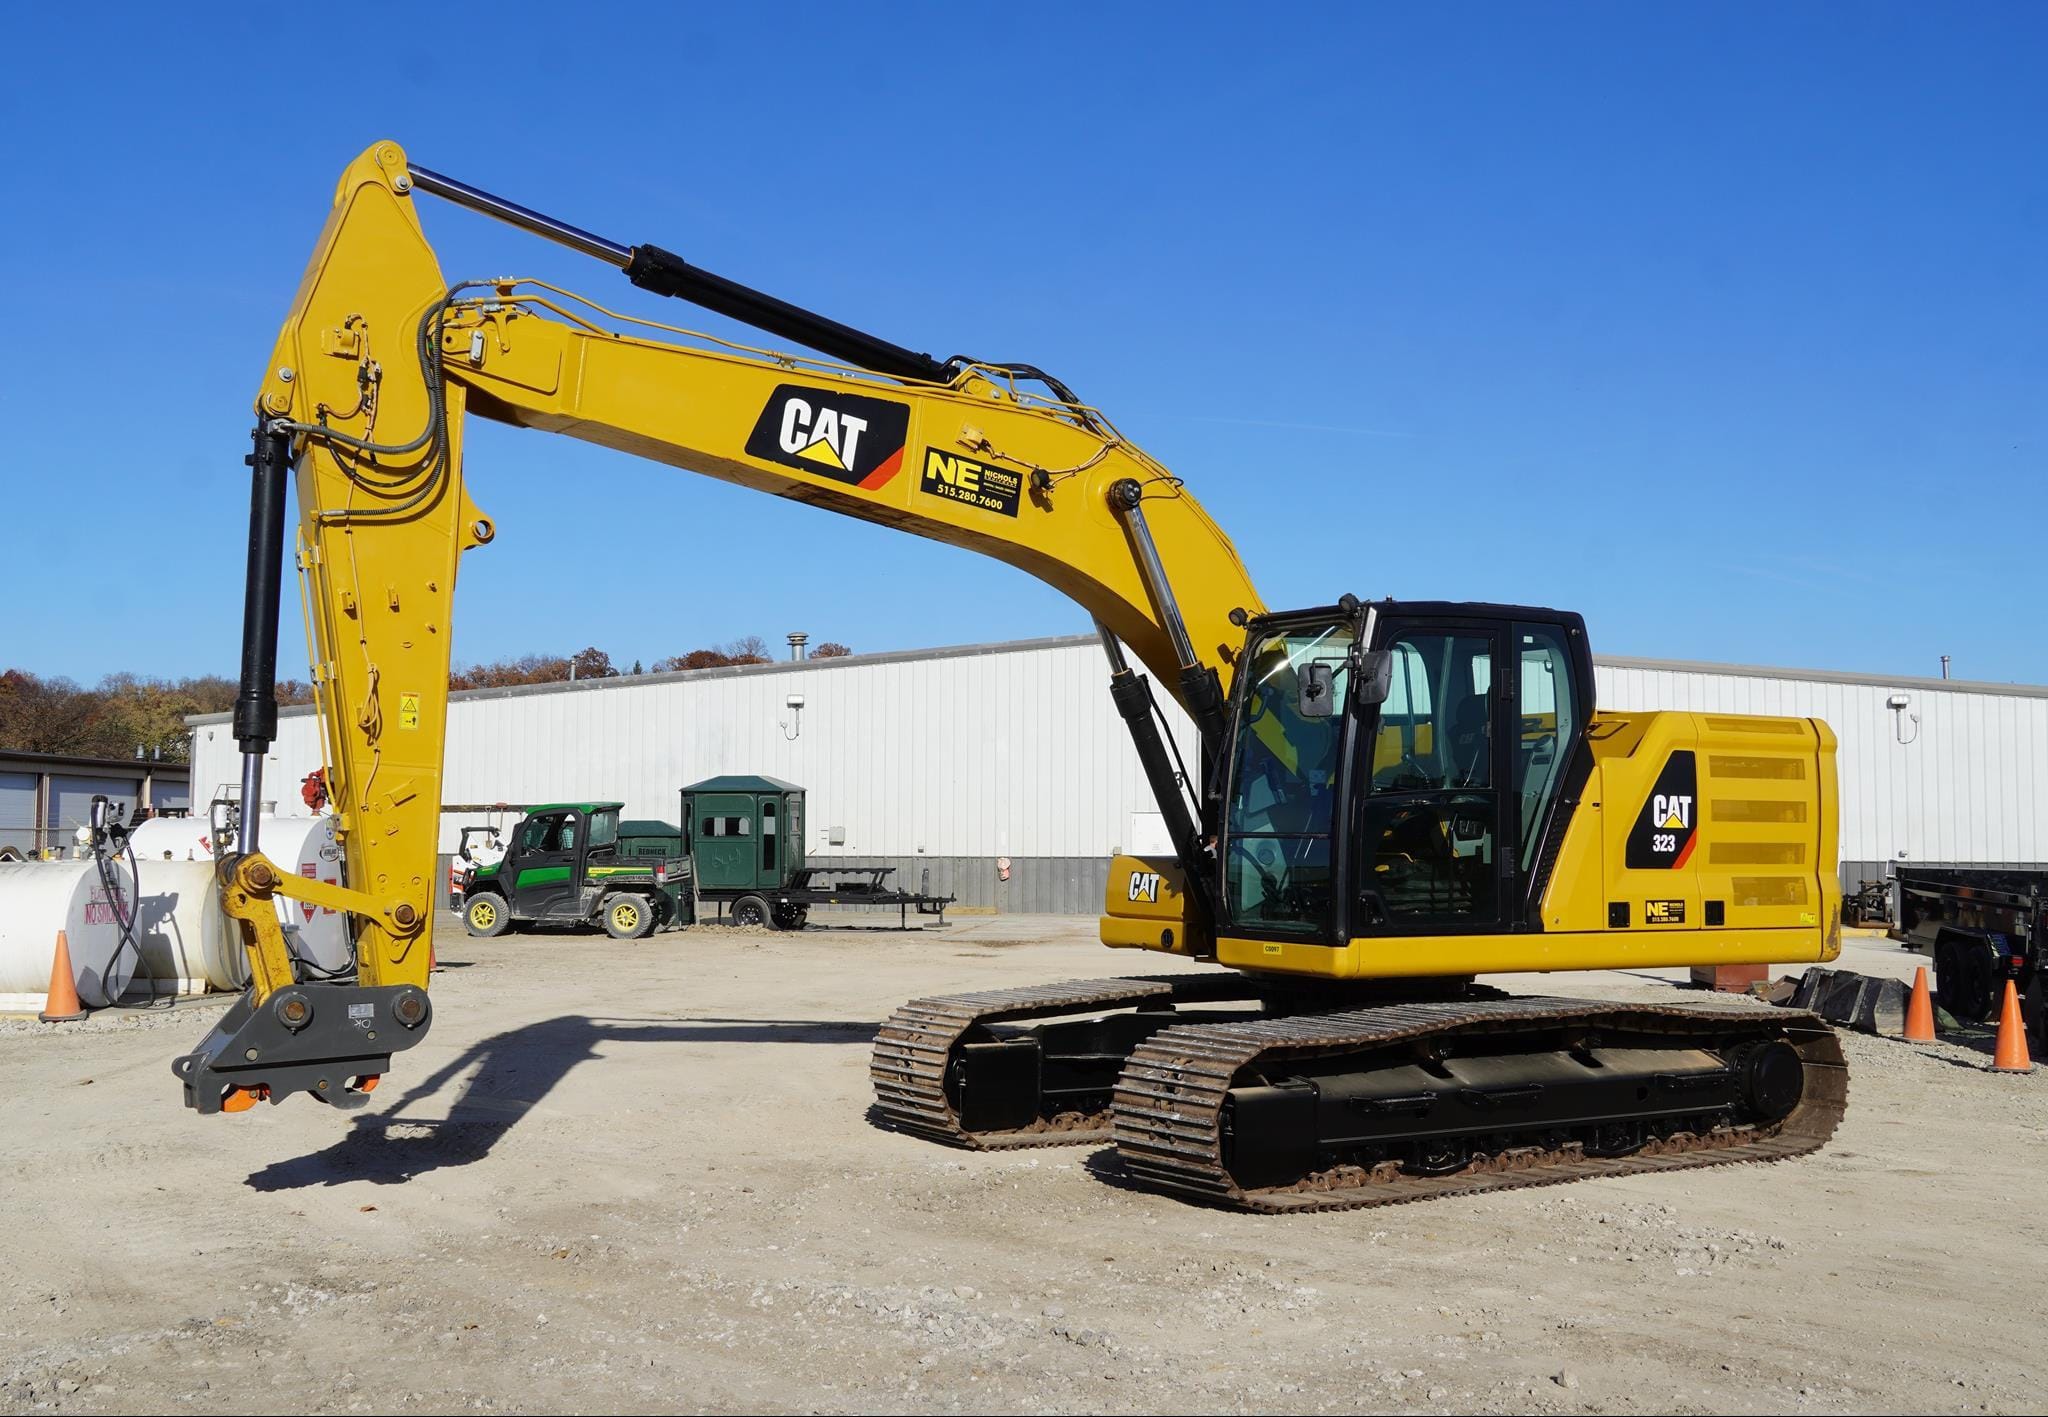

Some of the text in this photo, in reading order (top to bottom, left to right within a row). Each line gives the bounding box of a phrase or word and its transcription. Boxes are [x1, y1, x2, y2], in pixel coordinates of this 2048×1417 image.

[779, 398, 868, 472] CAT
[926, 451, 982, 492] NE
[984, 469, 1018, 485] NICHOLS
[937, 483, 1003, 510] 515.280.7600
[1653, 794, 1692, 829] CAT
[1652, 834, 1676, 852] 323
[1129, 872, 1160, 902] CAT
[1646, 902, 1669, 917] NE
